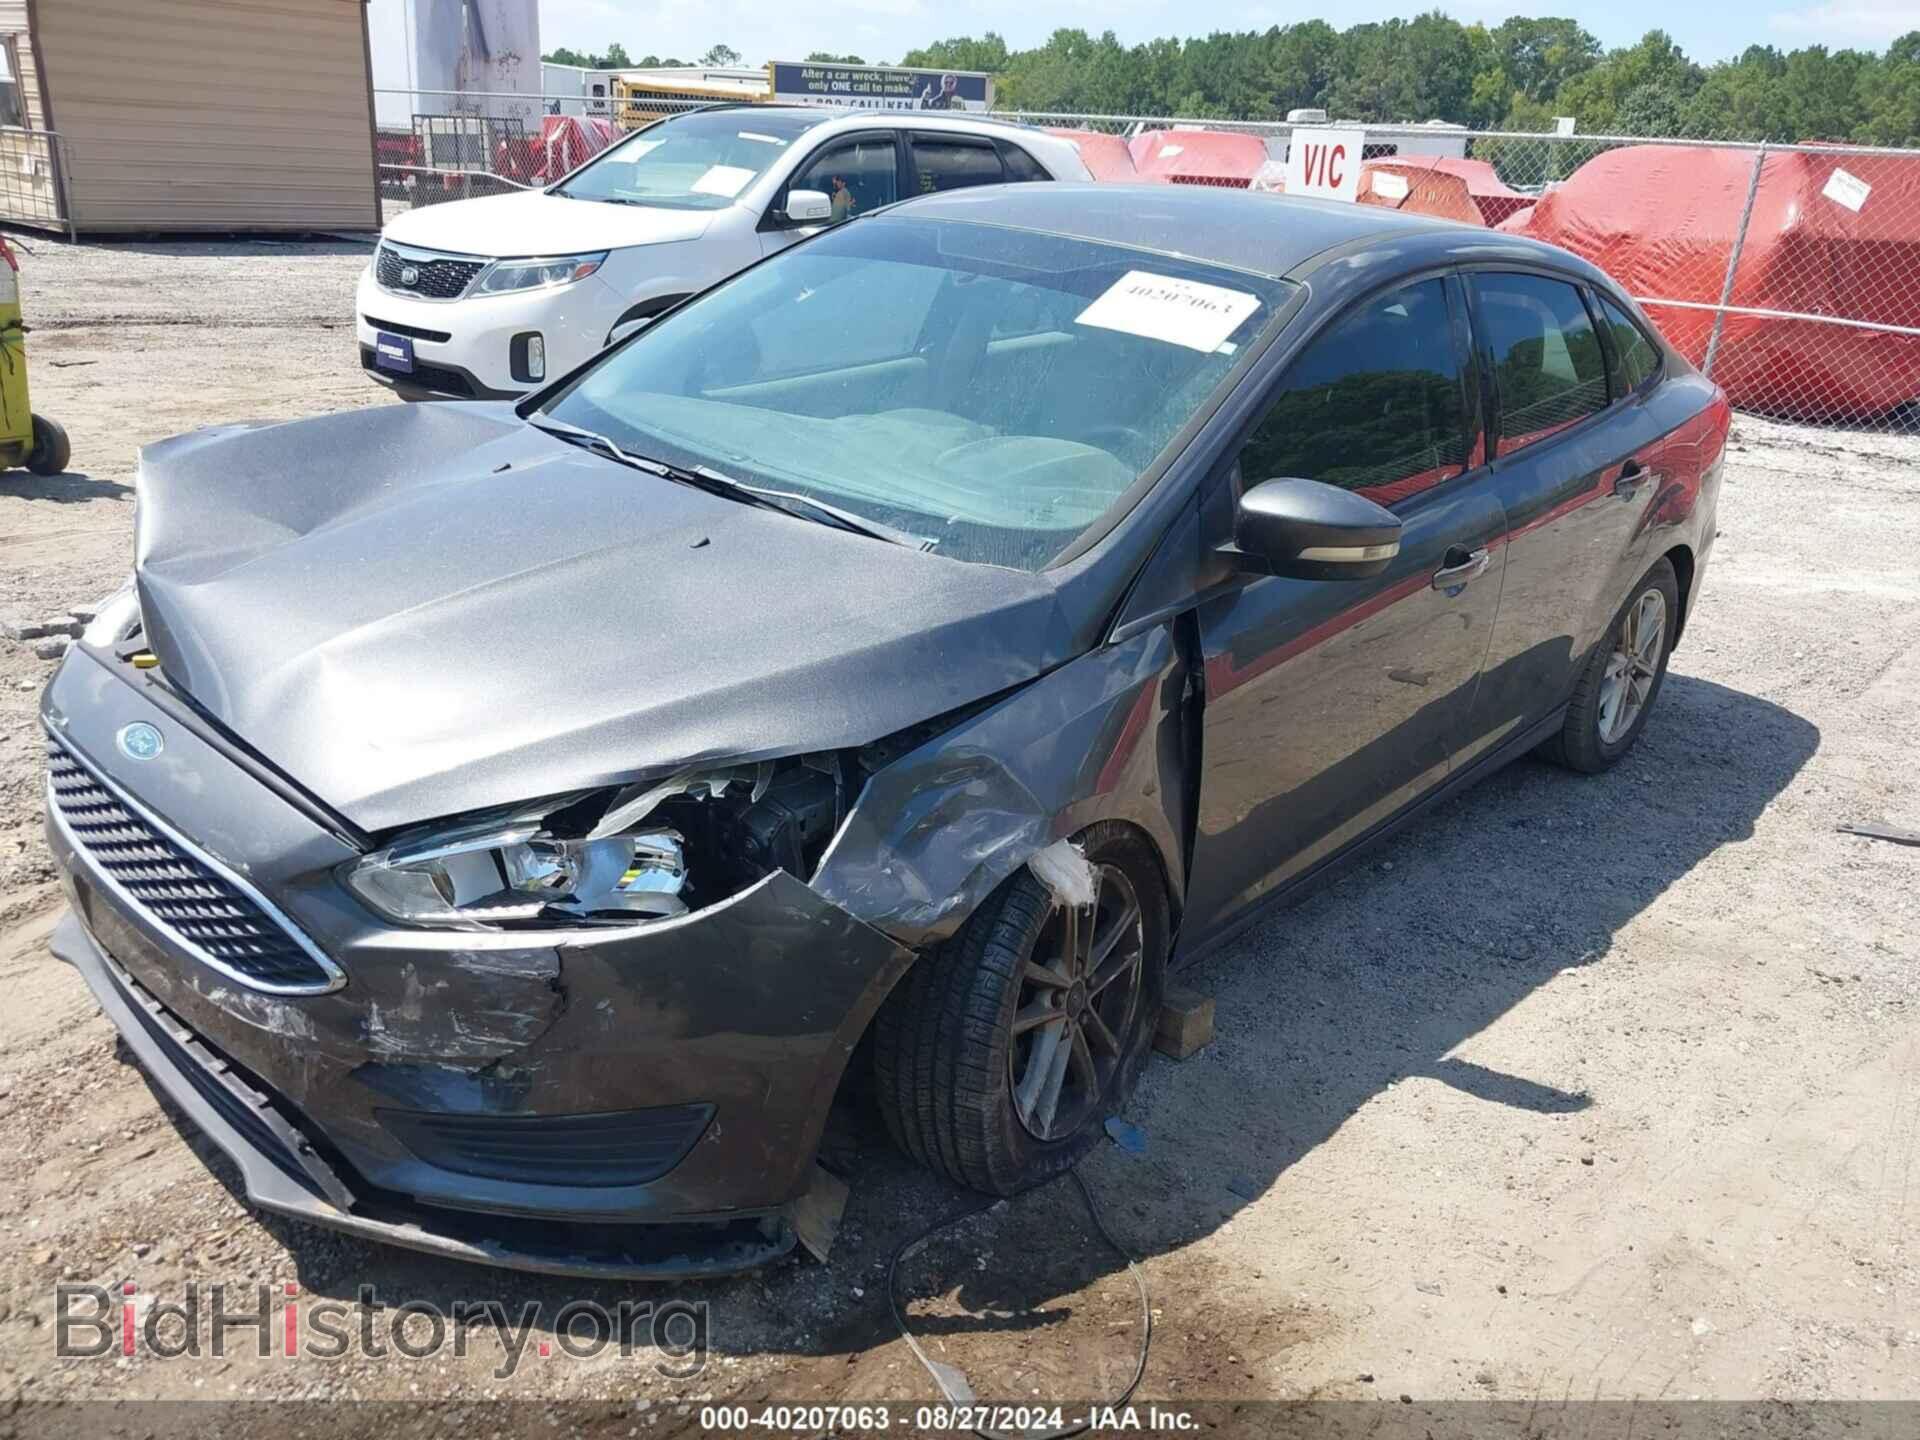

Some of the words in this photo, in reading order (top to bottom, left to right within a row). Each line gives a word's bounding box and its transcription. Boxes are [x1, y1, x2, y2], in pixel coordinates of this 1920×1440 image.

[801, 68, 825, 80] After
[827, 71, 833, 80] a
[835, 71, 849, 80] car
[808, 80, 830, 92] only
[831, 81, 852, 92] ONE
[853, 82, 870, 92] call
[872, 83, 883, 93] to
[1305, 144, 1345, 188] VIC
